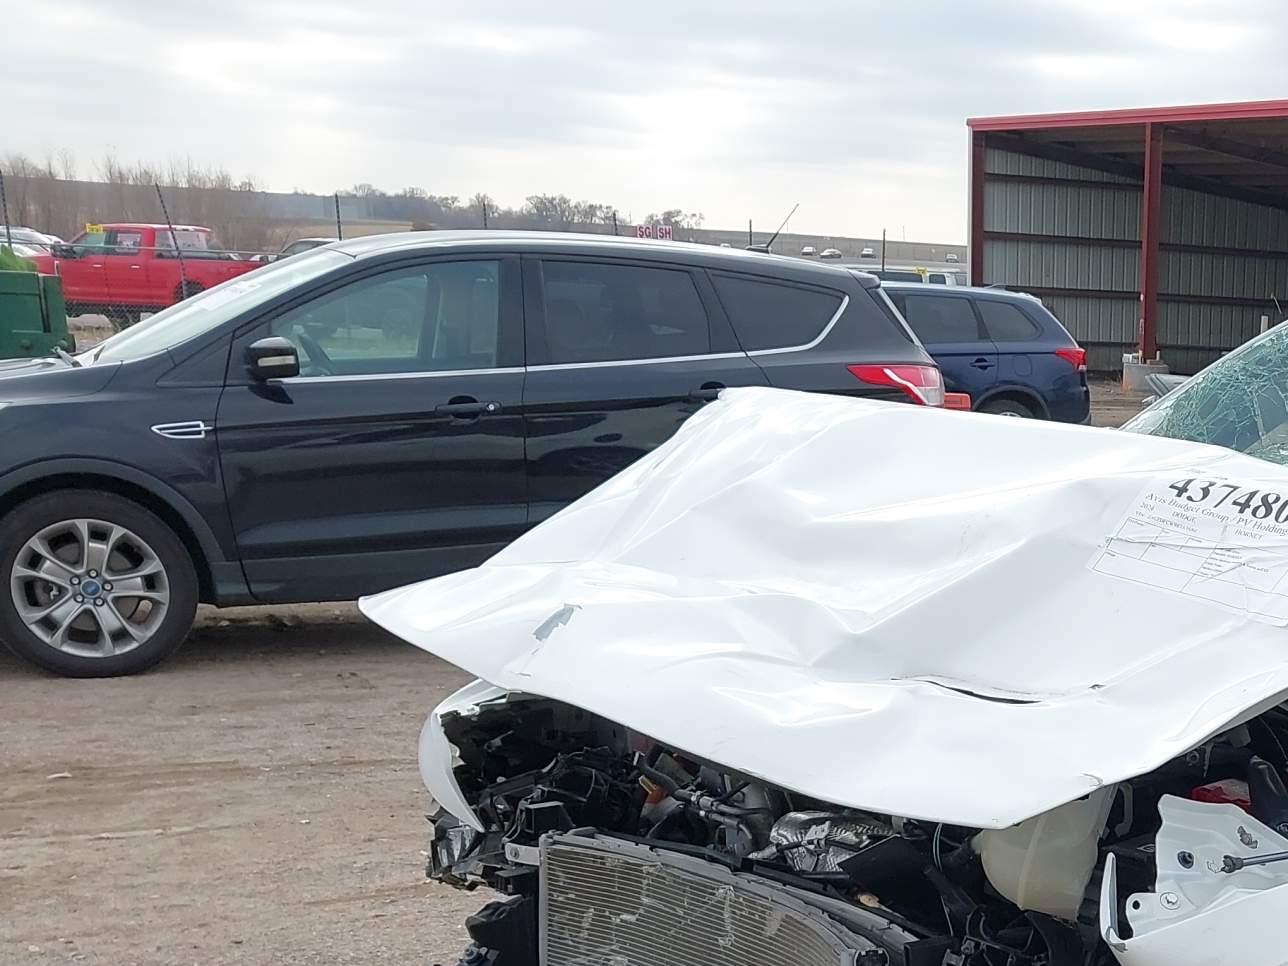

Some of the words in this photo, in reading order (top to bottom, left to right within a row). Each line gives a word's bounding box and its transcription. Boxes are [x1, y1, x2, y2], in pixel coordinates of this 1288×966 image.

[638, 225, 651, 239] SG
[658, 227, 671, 239] SH
[1145, 492, 1167, 504] Avis
[1168, 498, 1201, 513] Budget
[1201, 508, 1230, 522] Group
[1236, 516, 1253, 527] PV
[1252, 520, 1288, 537] Holding
[1171, 510, 1196, 523] DODGE
[1234, 528, 1265, 540] HORNET
